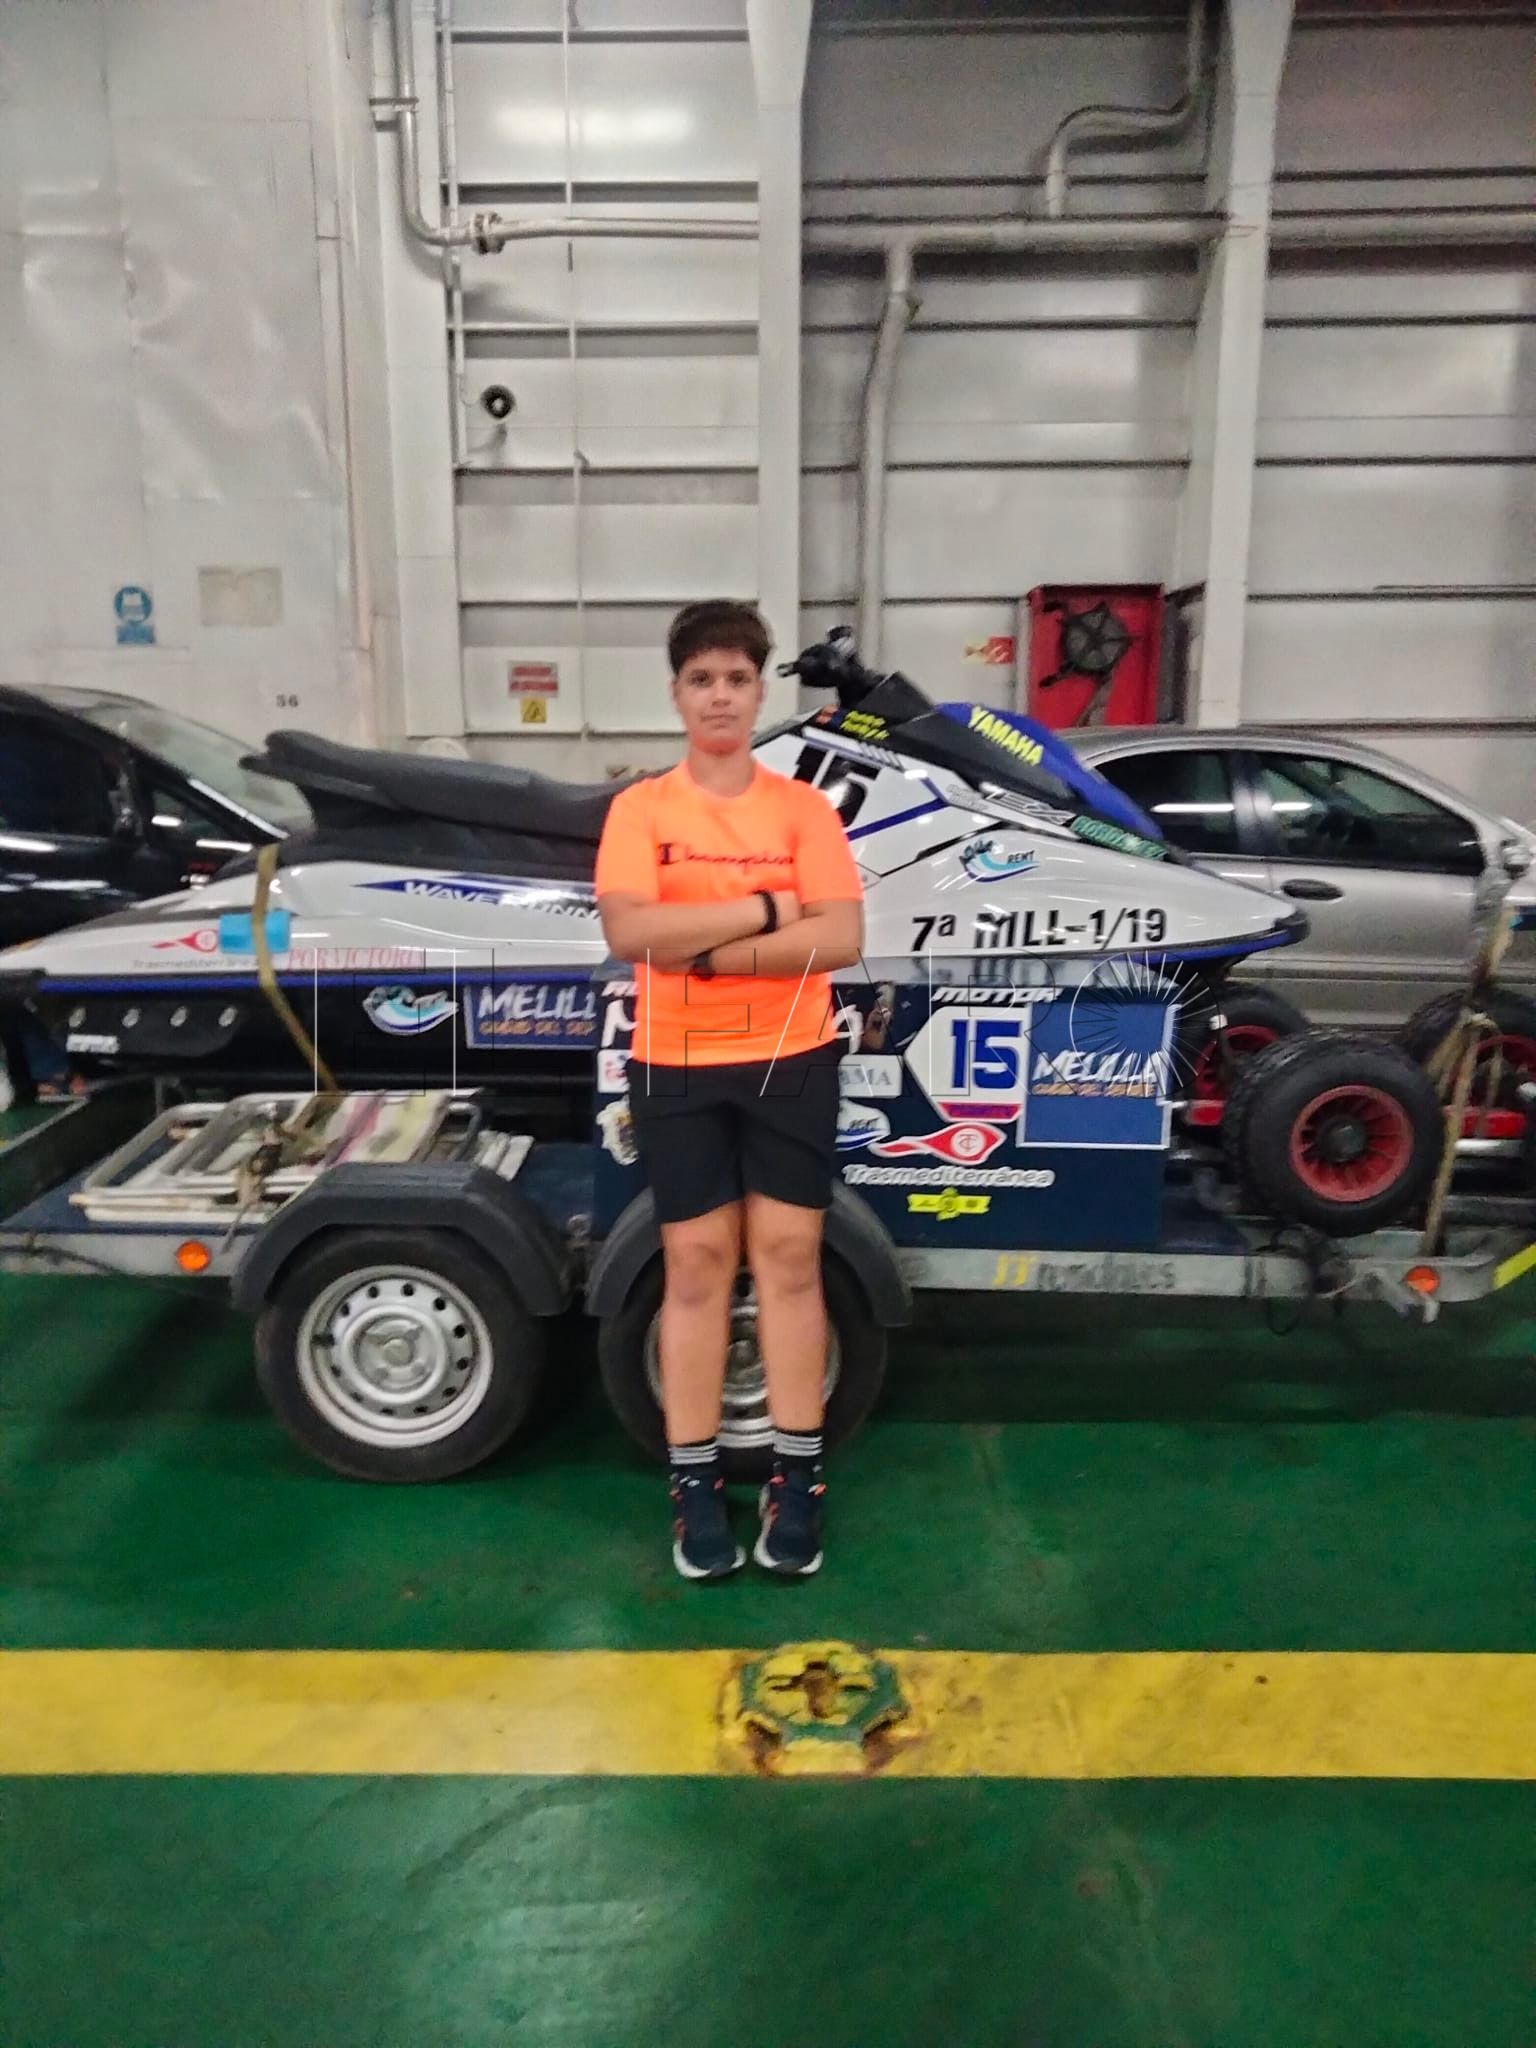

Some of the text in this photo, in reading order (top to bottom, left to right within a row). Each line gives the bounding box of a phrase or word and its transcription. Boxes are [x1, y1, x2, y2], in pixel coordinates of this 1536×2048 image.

[967, 704, 1045, 767] YAMAHA
[930, 987, 1062, 1004] MOTOR
[951, 1019, 1024, 1090] 15
[843, 1165, 1055, 1188] Trasmediterránea
